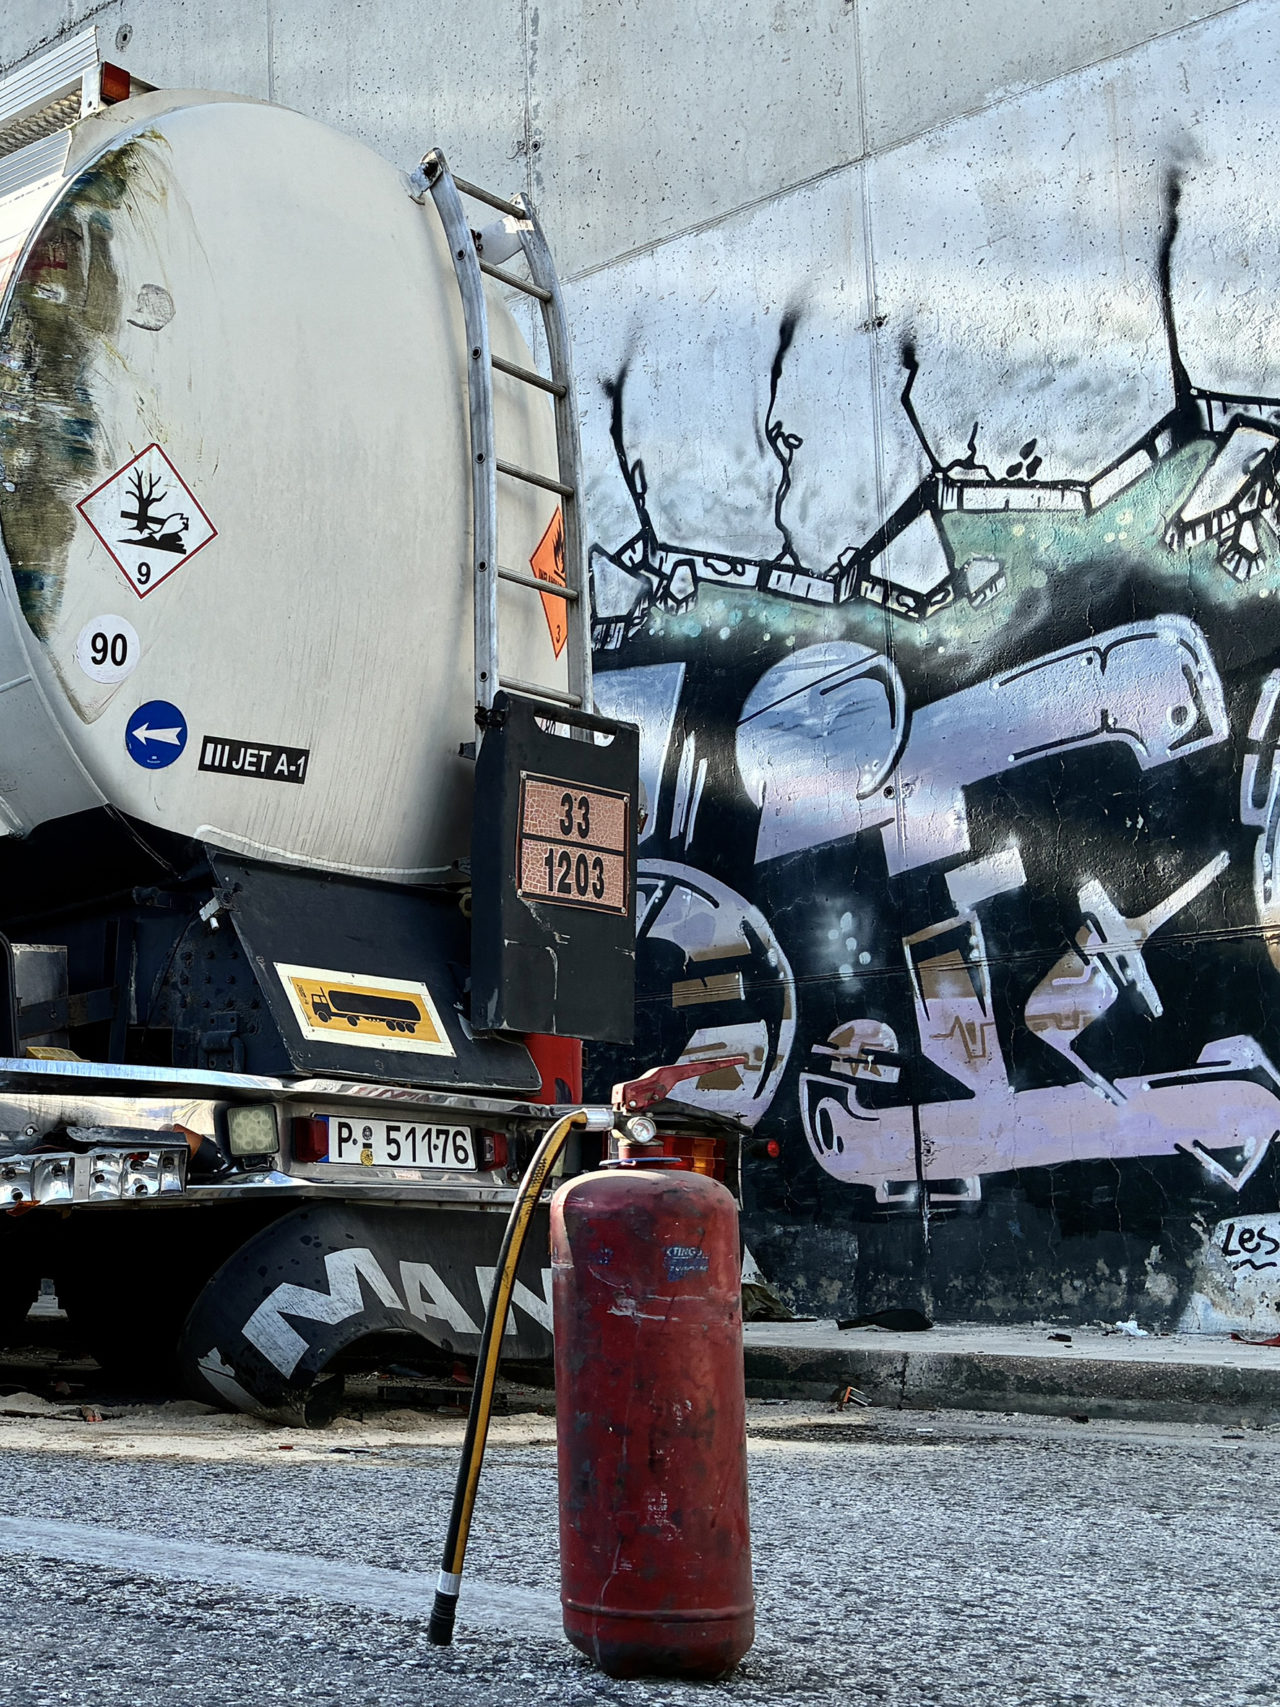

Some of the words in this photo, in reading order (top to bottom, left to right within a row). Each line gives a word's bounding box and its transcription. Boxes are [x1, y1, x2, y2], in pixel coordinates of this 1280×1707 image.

[137, 562, 151, 585] 9
[91, 632, 128, 667] 90
[555, 624, 561, 644] 3
[232, 747, 272, 773] JET
[273, 753, 306, 778] A-1
[559, 793, 590, 839] 33
[545, 848, 605, 899] 1203
[337, 1121, 353, 1159] P
[386, 1124, 470, 1165] 51176
[1222, 1223, 1280, 1256] Les
